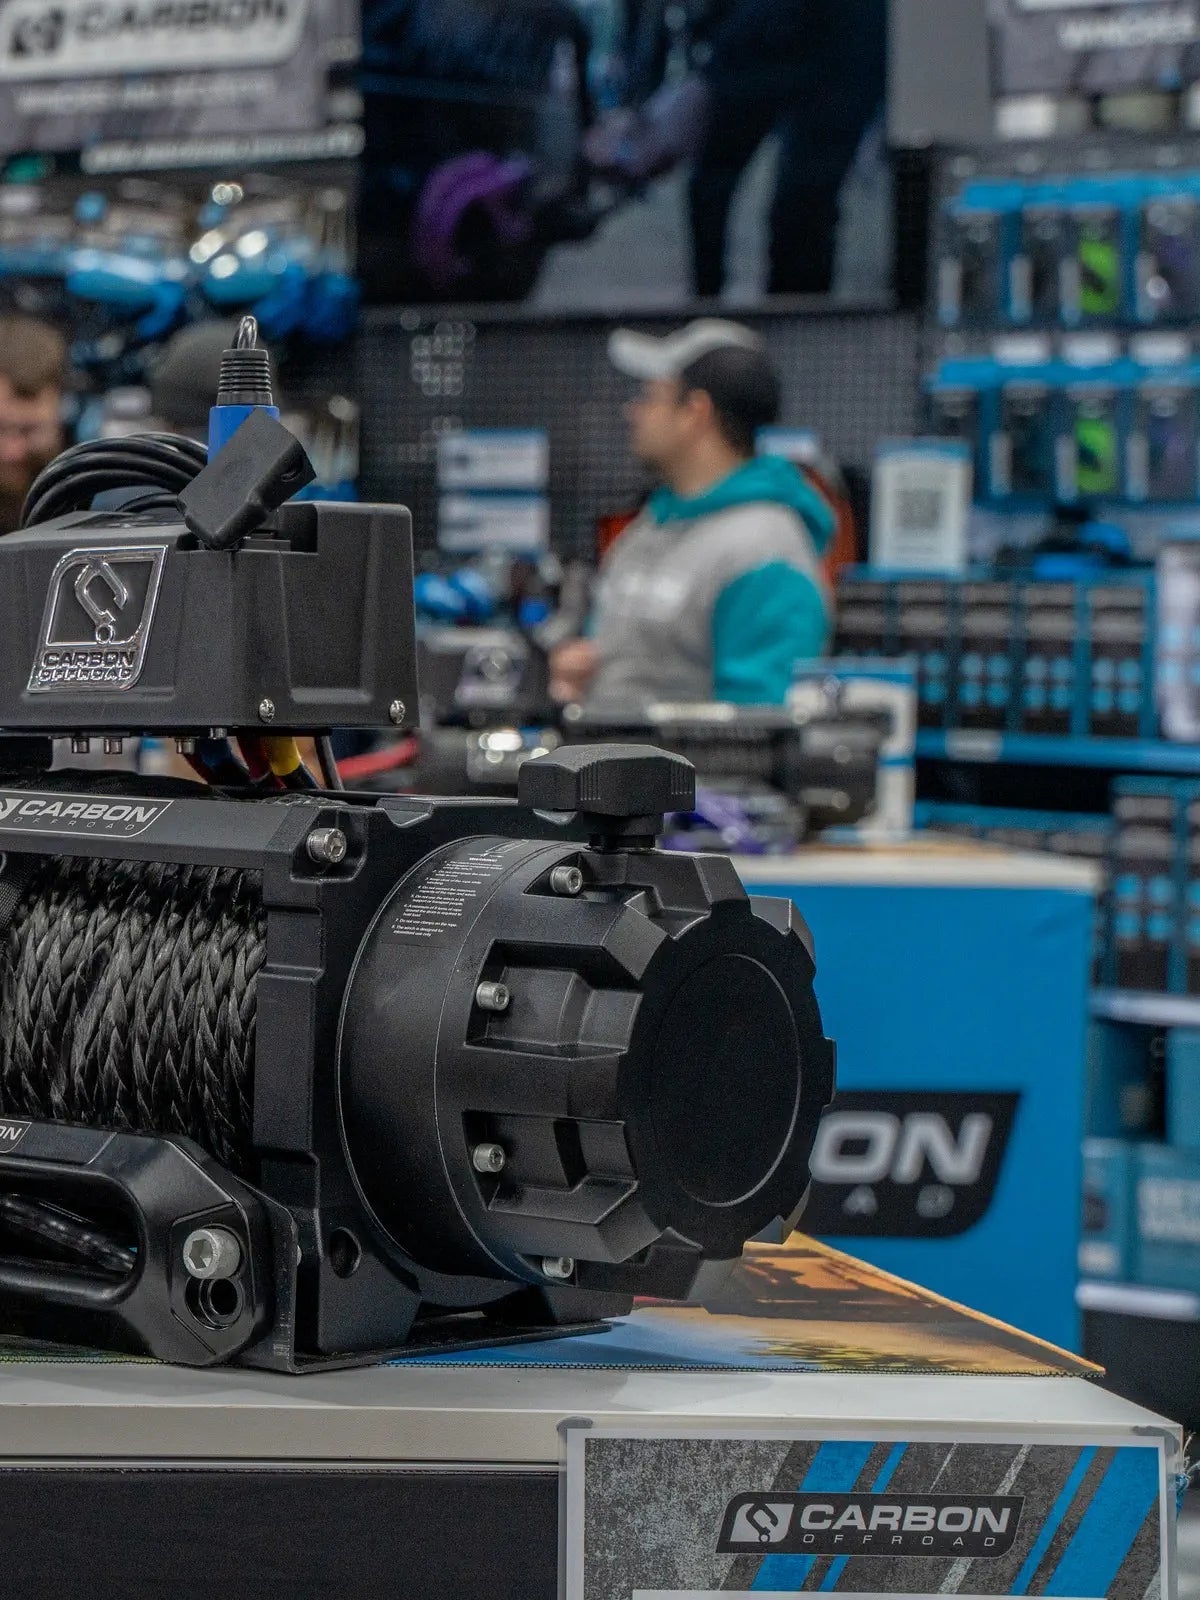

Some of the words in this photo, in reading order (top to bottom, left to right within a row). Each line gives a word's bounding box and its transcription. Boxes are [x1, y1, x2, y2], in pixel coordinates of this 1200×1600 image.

[42, 651, 135, 668] CARBON
[18, 799, 158, 823] CARBON
[12, 816, 135, 831] OFFROAD
[800, 1503, 1010, 1534] CARBON
[802, 1533, 996, 1548] OFFROAD
